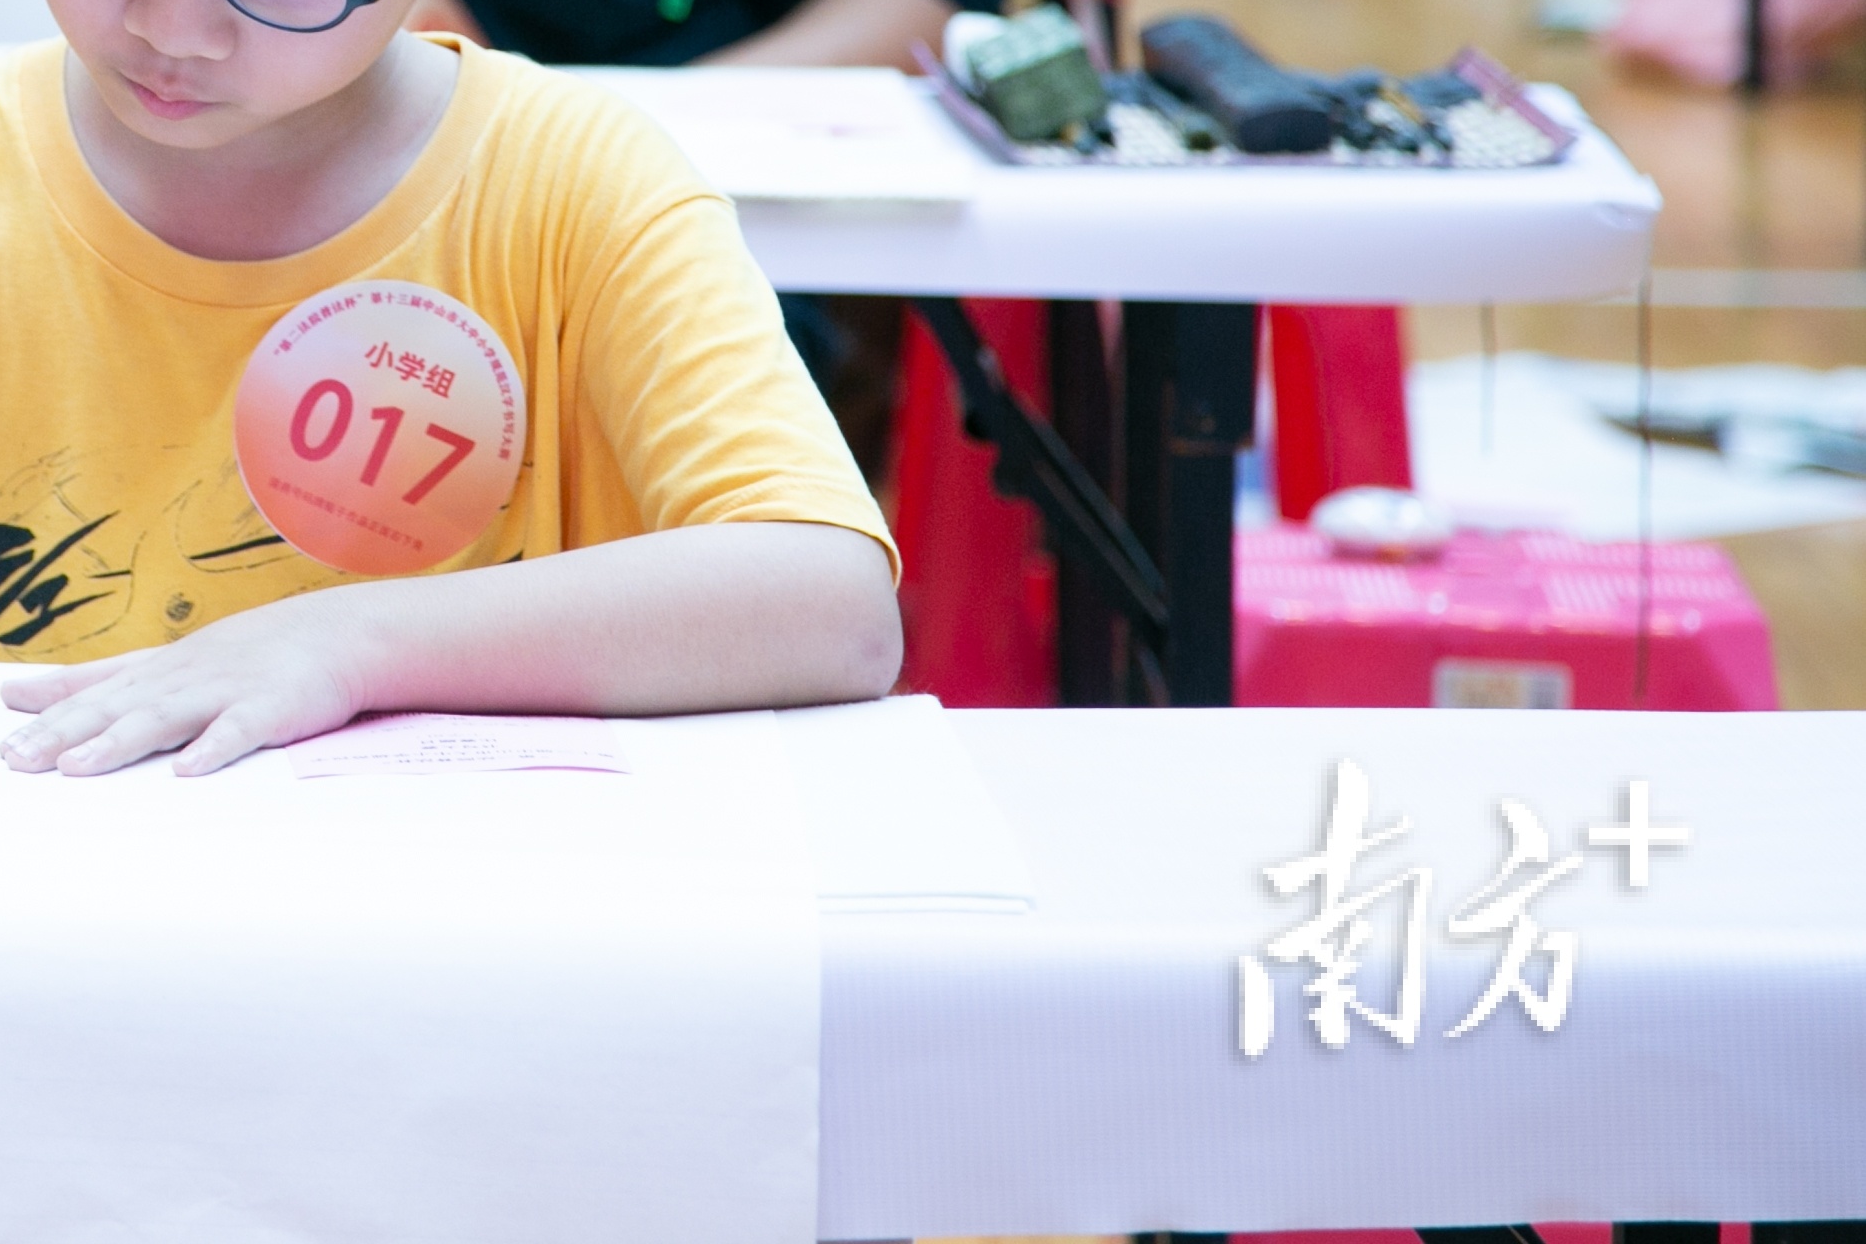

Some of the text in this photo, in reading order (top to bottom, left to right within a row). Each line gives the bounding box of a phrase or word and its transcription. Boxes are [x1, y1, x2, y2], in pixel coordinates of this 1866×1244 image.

[364, 341, 456, 399] 小学组
[289, 378, 476, 506] 017
